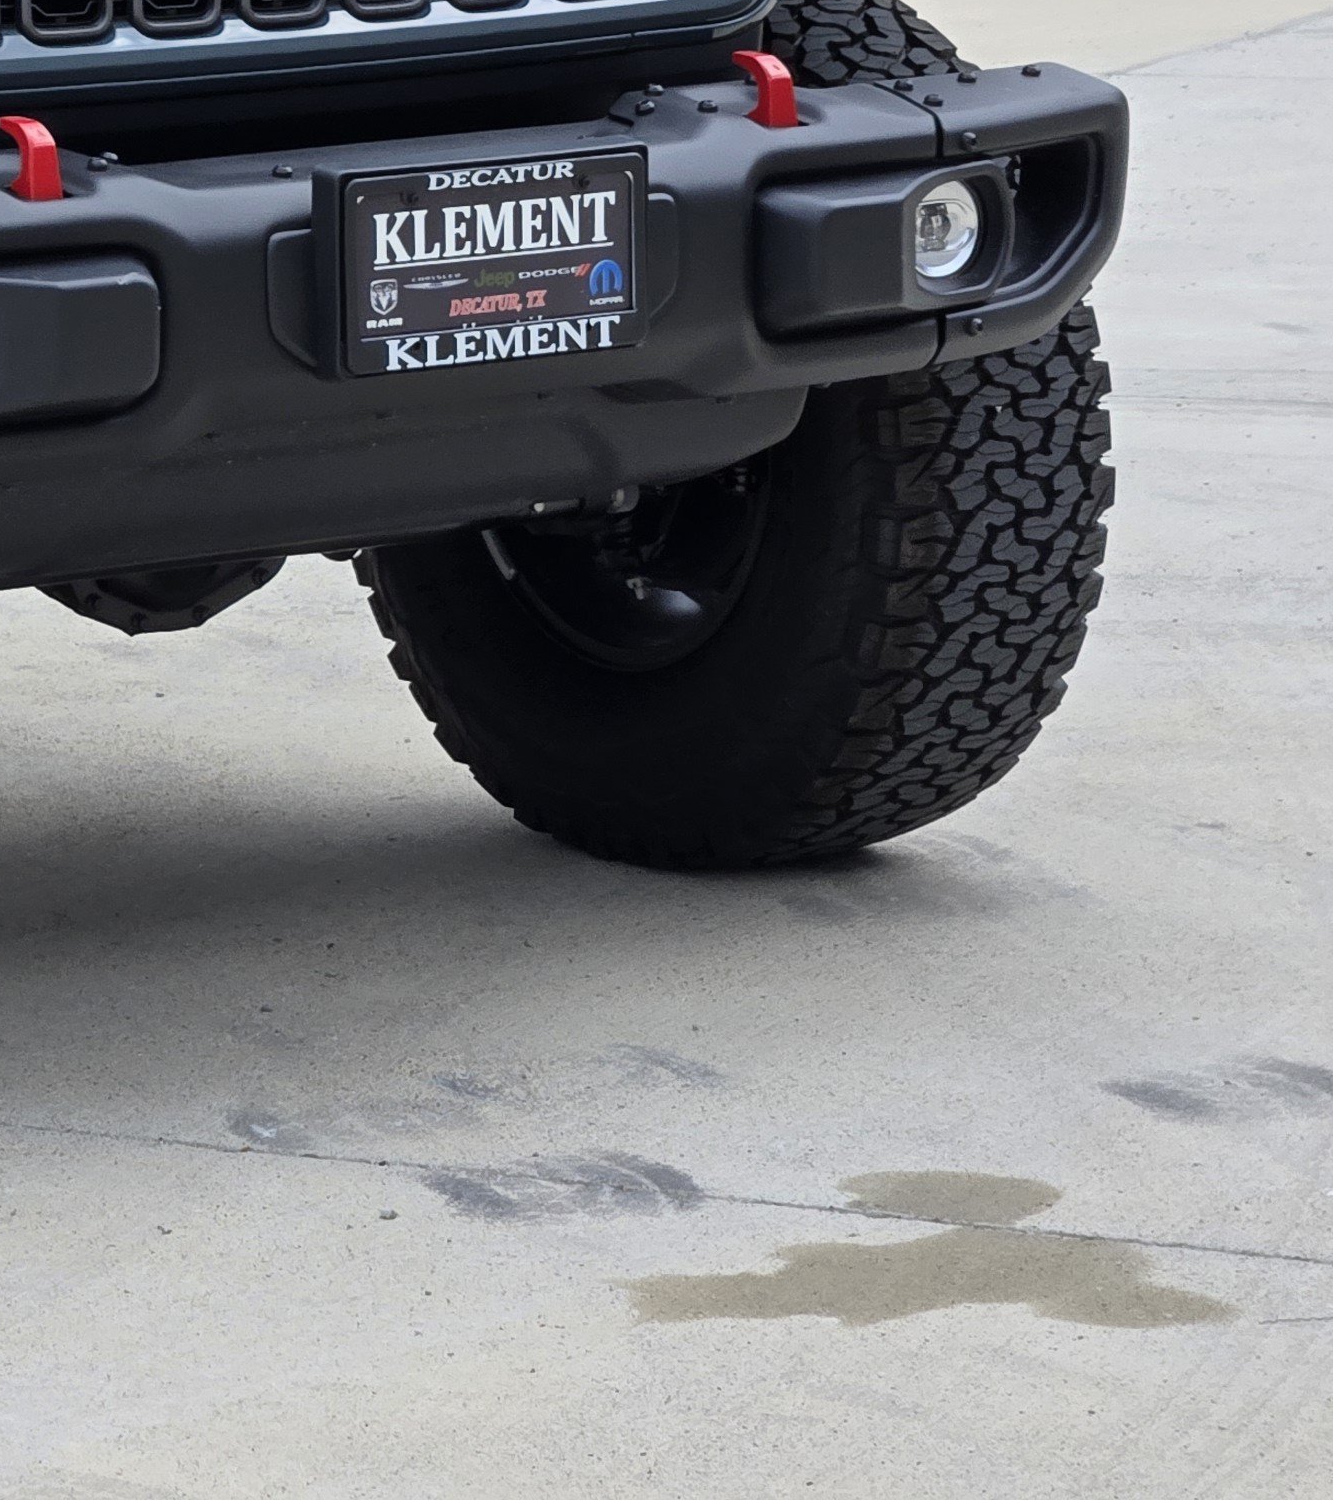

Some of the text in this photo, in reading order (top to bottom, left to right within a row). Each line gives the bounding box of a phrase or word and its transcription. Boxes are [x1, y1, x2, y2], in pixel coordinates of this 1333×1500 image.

[427, 161, 575, 191] DECATUR
[373, 190, 616, 265] KLEMENT
[474, 269, 515, 289] Jeep
[518, 266, 580, 280] DODGE
[526, 289, 548, 309] TX
[385, 315, 621, 372] KLEMENT
